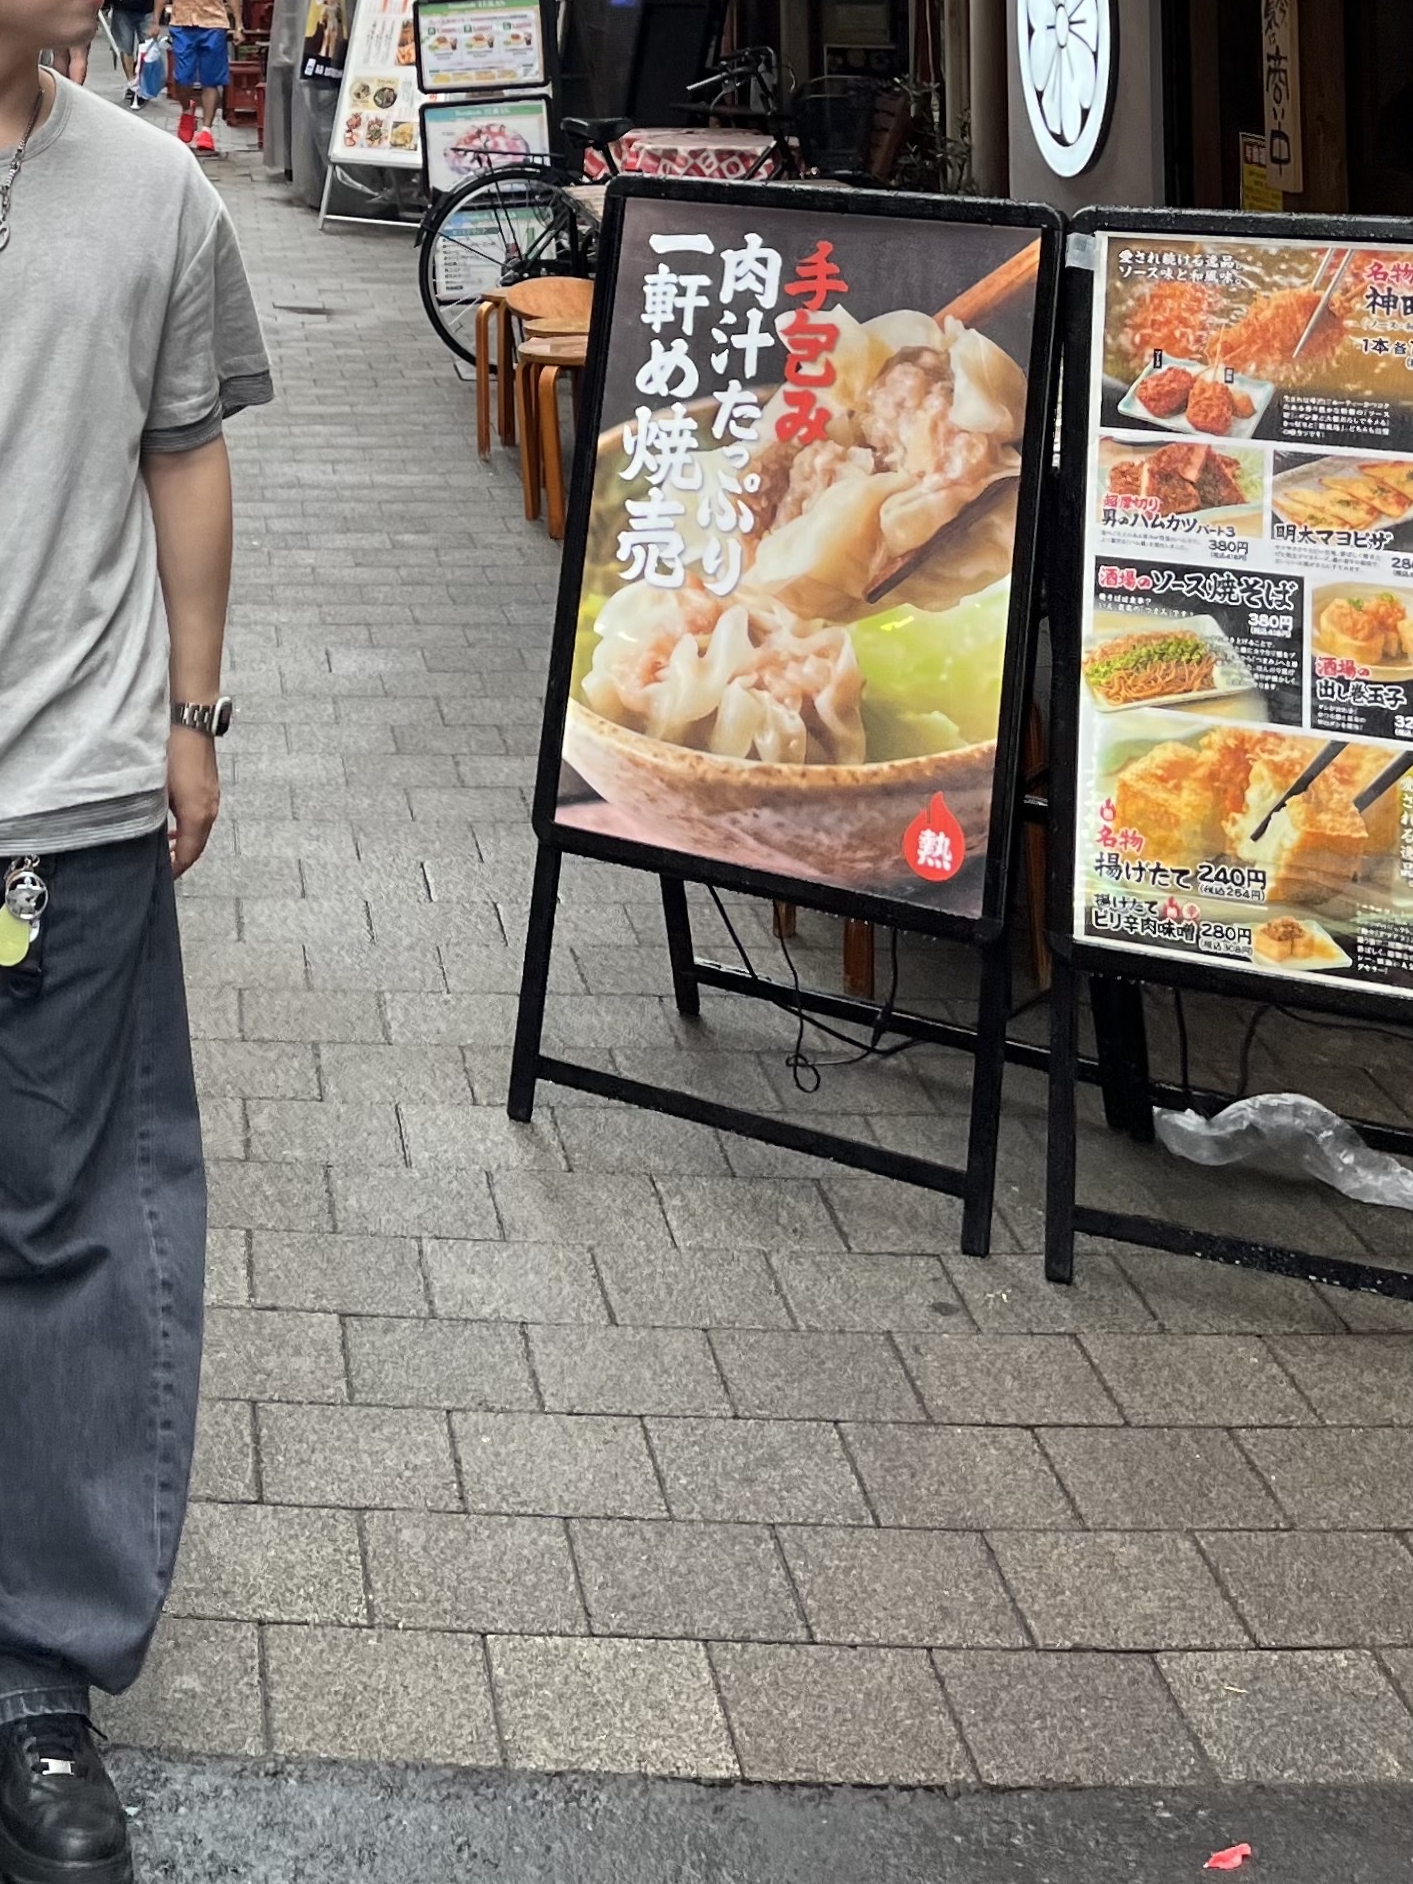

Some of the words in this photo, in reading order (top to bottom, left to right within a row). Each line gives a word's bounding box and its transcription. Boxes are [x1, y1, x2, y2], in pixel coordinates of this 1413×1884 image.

[774, 241, 849, 445] 手包み
[617, 231, 714, 590] 一軒め焼売
[695, 233, 782, 597] 肉汁たっぷり
[1208, 540, 1249, 556] 380円
[1391, 557, 1413, 569] 28
[1248, 613, 1293, 631] 380円
[916, 826, 954, 872] 熱
[1096, 824, 1145, 854] 名物
[1094, 851, 1193, 890] 揚げたて
[1197, 864, 1267, 890] 240円
[1201, 923, 1252, 945] 280円
